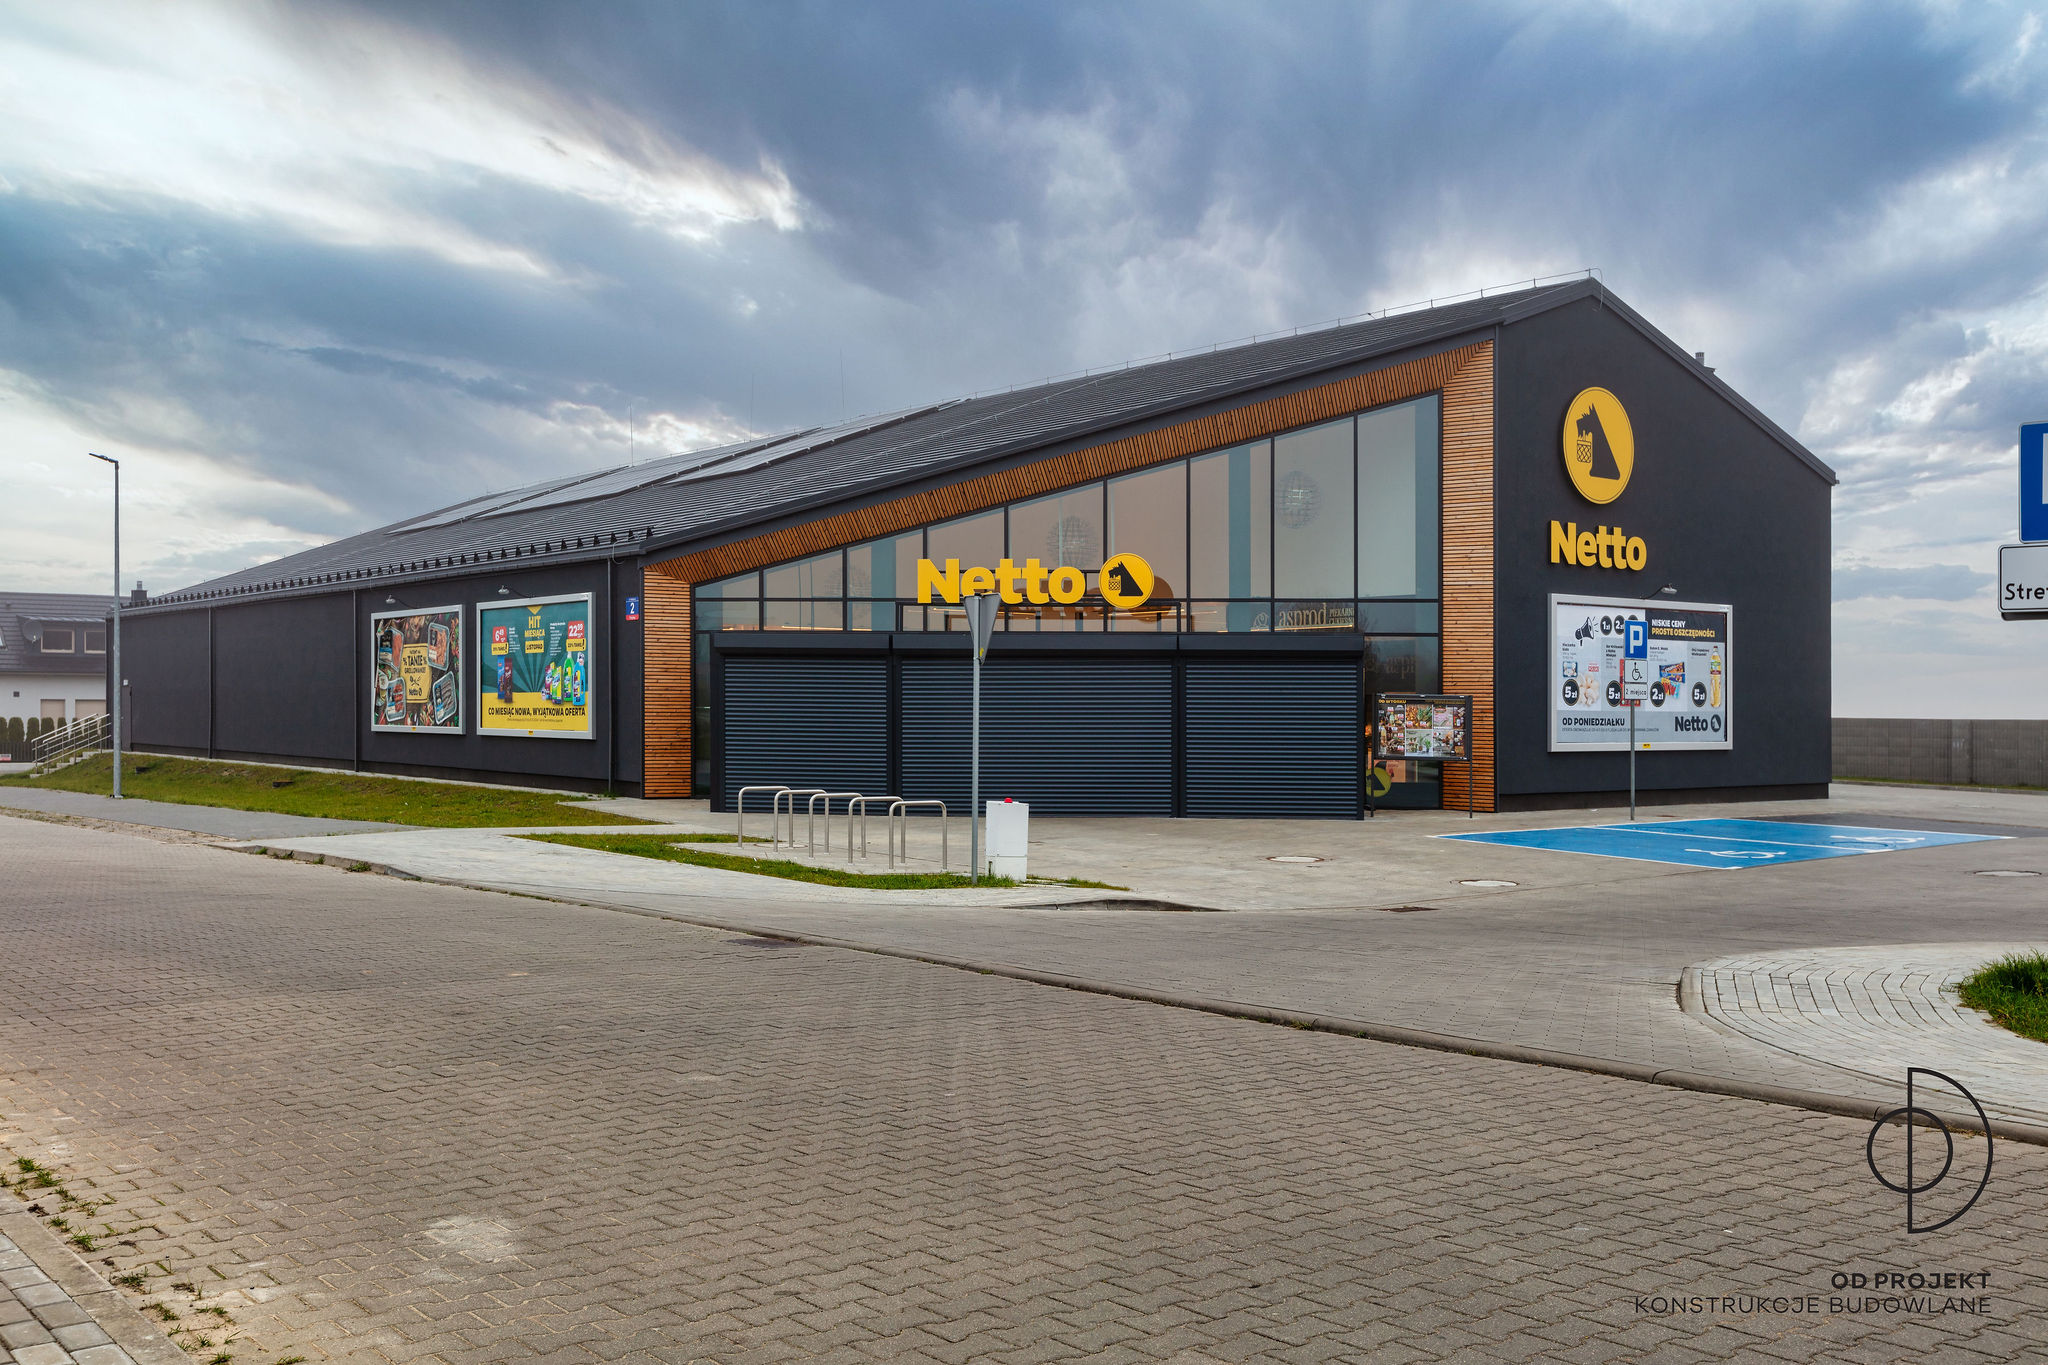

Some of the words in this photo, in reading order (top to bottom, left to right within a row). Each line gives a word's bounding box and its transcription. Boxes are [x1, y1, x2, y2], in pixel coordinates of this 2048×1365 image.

[1551, 520, 1648, 571] Netto
[917, 559, 1086, 605] Netto
[2004, 583, 2048, 600] Stre
[630, 602, 635, 614] 2
[528, 615, 541, 628] HIT
[1279, 602, 1327, 629] asprod
[1652, 619, 1670, 627] NISKIE
[1671, 620, 1686, 628] CENY
[1652, 627, 1673, 636] PROSTE
[1629, 625, 1643, 654] P
[488, 707, 494, 715] CO
[565, 707, 586, 716] OFERTA
[1562, 717, 1572, 726] OD
[1574, 717, 1625, 726] PONIEDZIAŁKU
[1675, 716, 1708, 732] Netto
